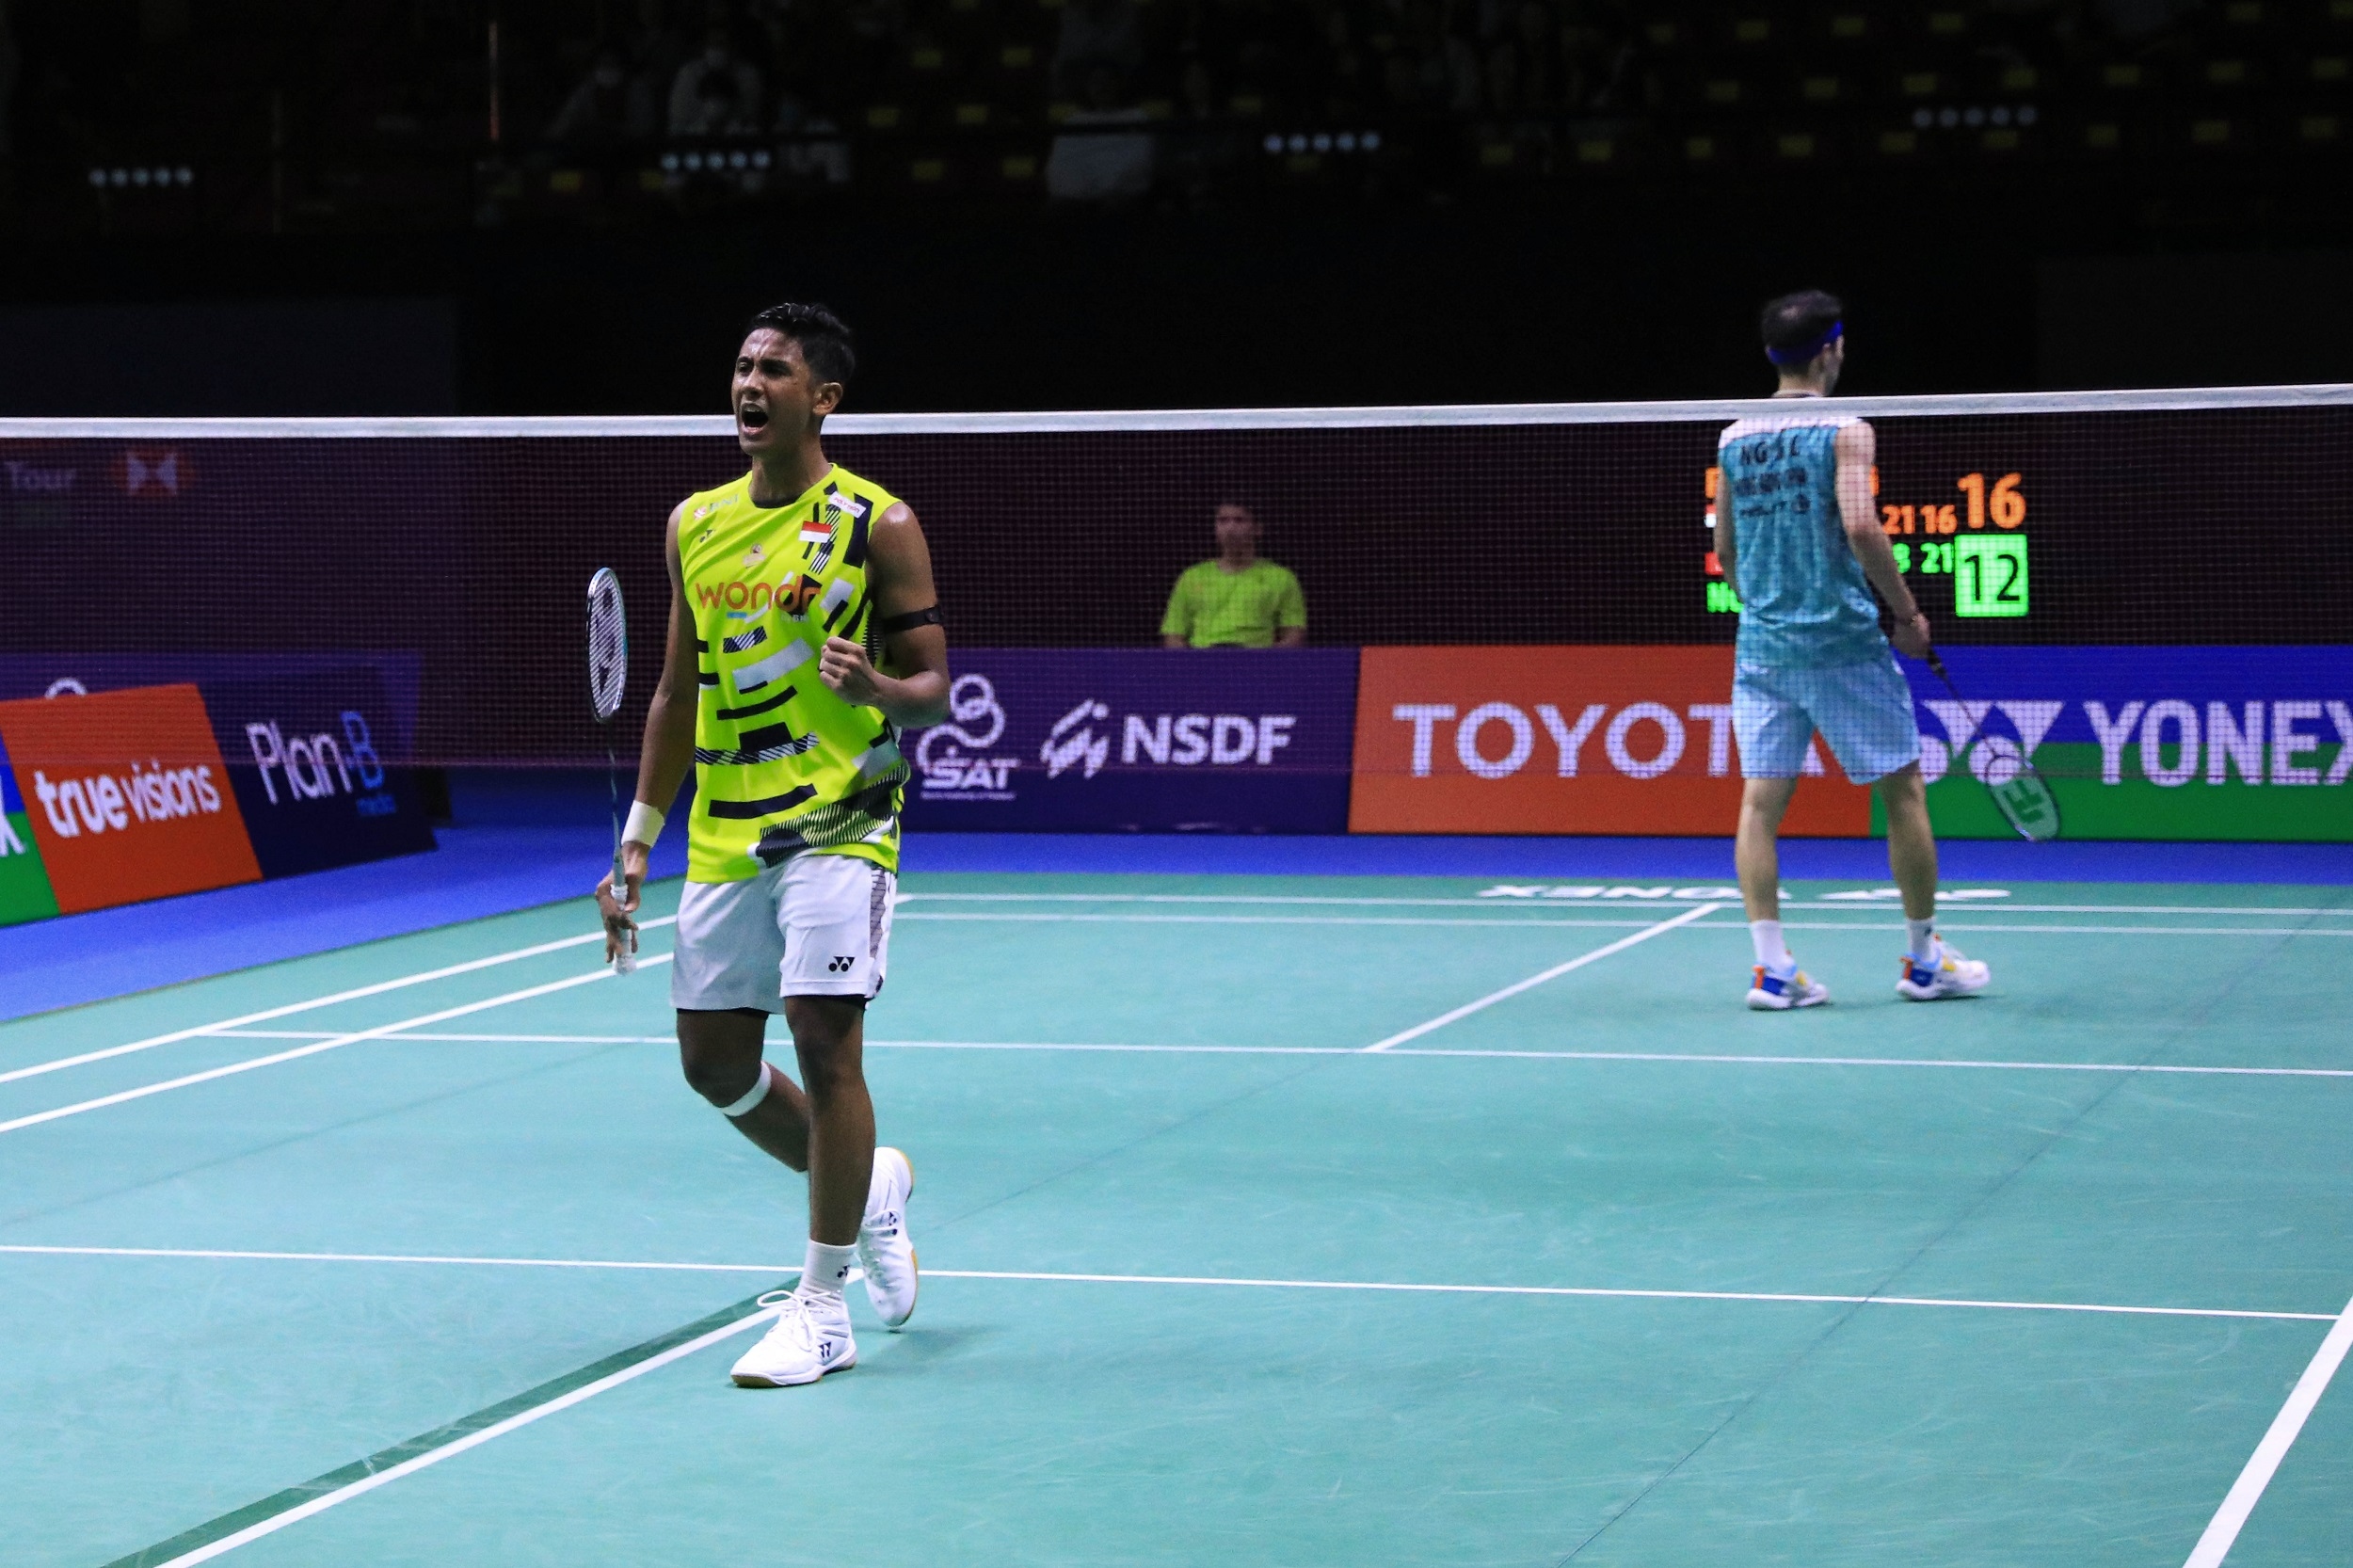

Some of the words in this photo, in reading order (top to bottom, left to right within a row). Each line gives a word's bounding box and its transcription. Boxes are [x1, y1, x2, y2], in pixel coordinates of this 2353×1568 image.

[1882, 504, 1915, 535] 21
[1920, 504, 1958, 535] 16
[1958, 472, 2026, 529] 16
[695, 575, 822, 613] wondr
[1920, 542, 1953, 574] 21
[1964, 553, 2021, 601] 12
[1121, 713, 1296, 765] NSDF
[922, 757, 1022, 789] SAT
